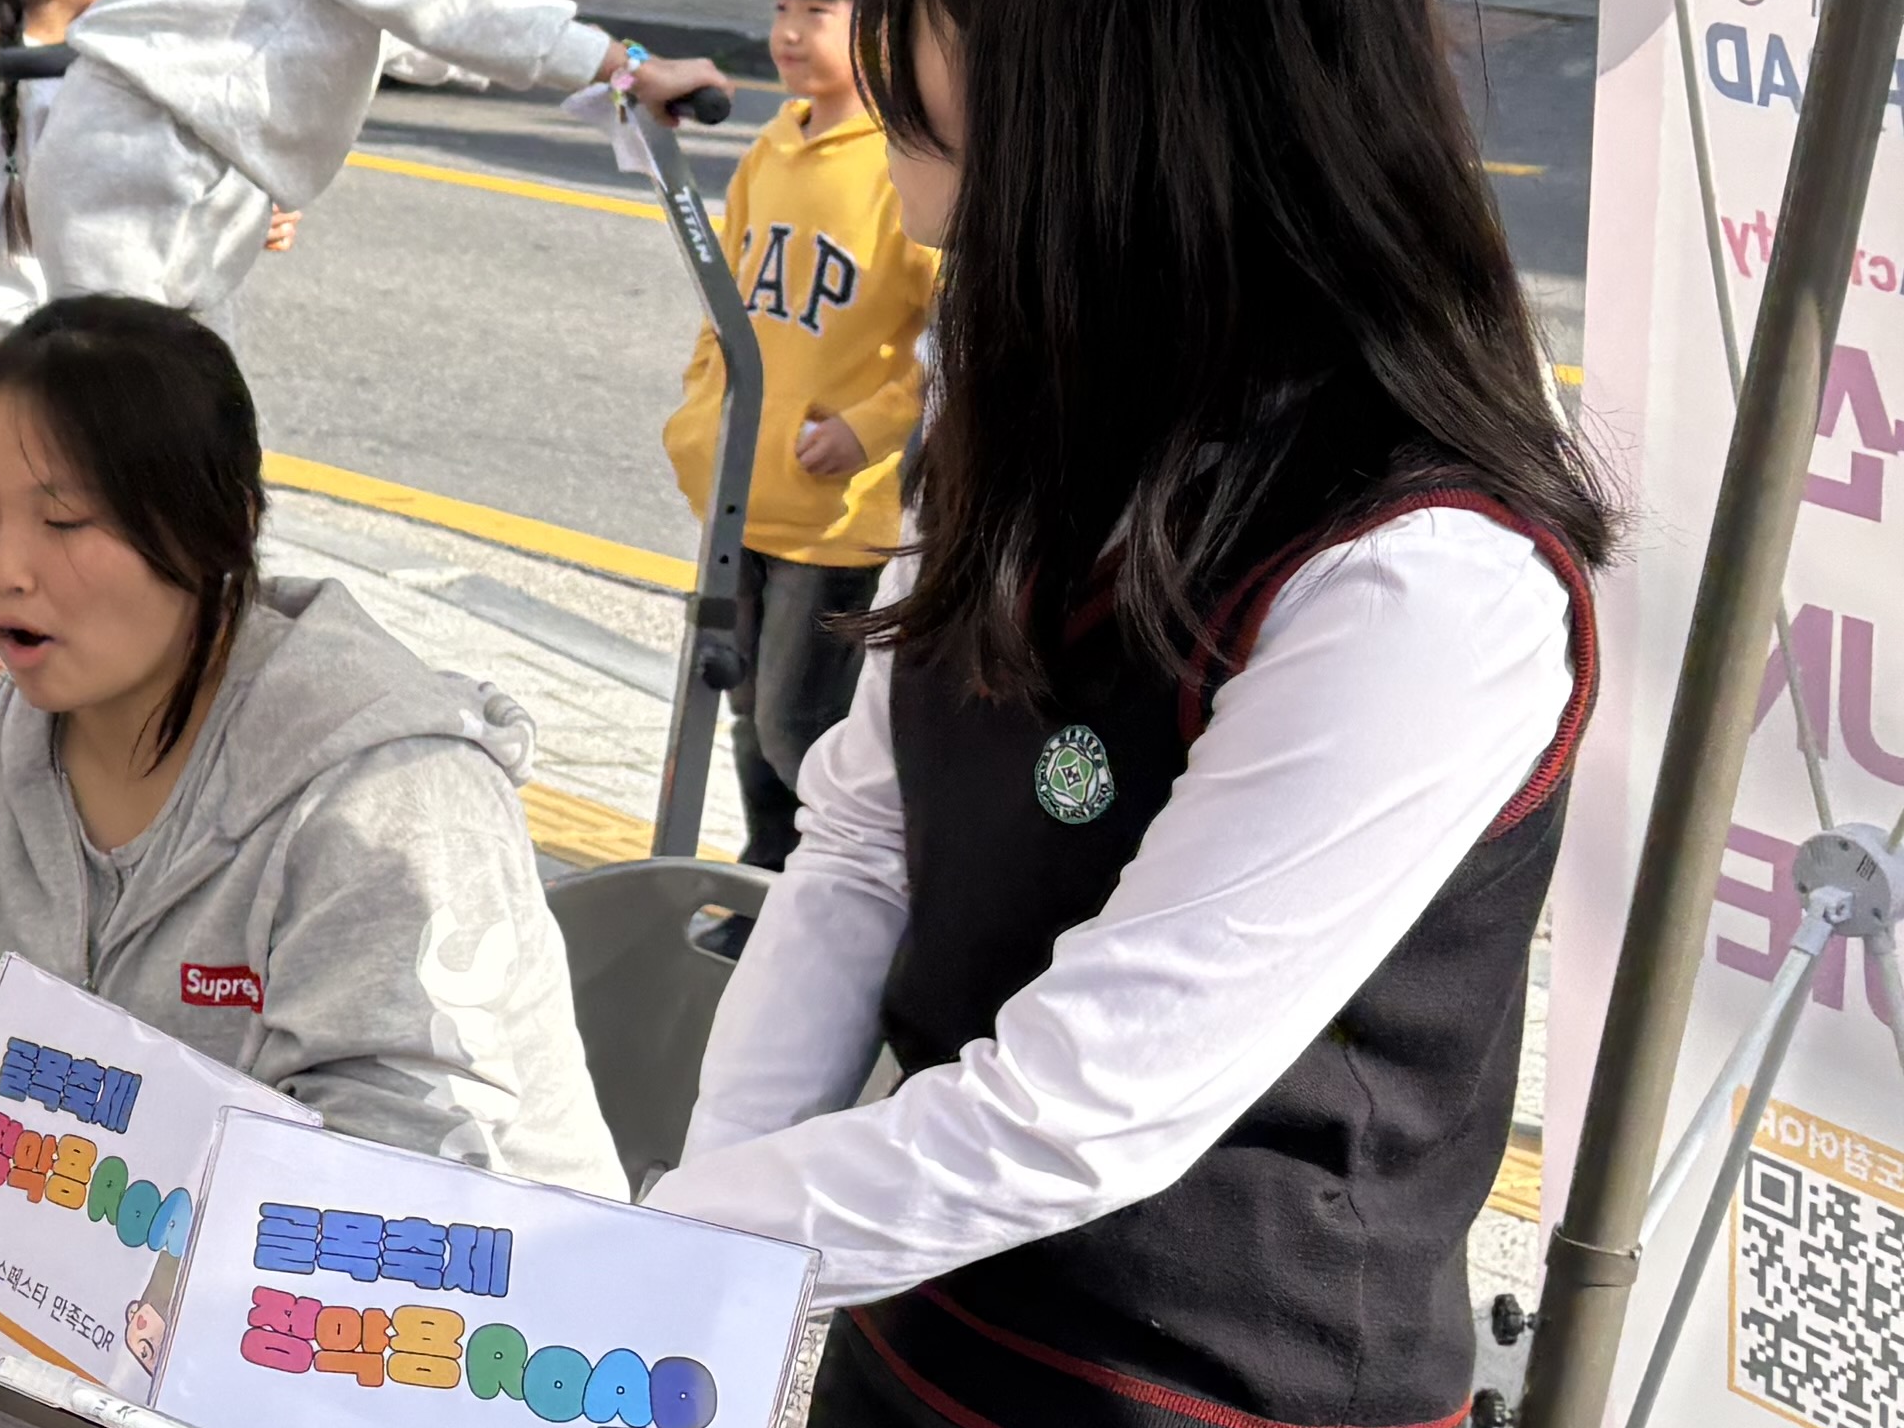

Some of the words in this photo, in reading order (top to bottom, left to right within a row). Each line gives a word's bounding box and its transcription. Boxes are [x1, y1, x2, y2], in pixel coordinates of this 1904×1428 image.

[675, 189, 713, 264] TITAN
[253, 1201, 512, 1298] 골목축제
[50, 1293, 116, 1354] 만족도QR
